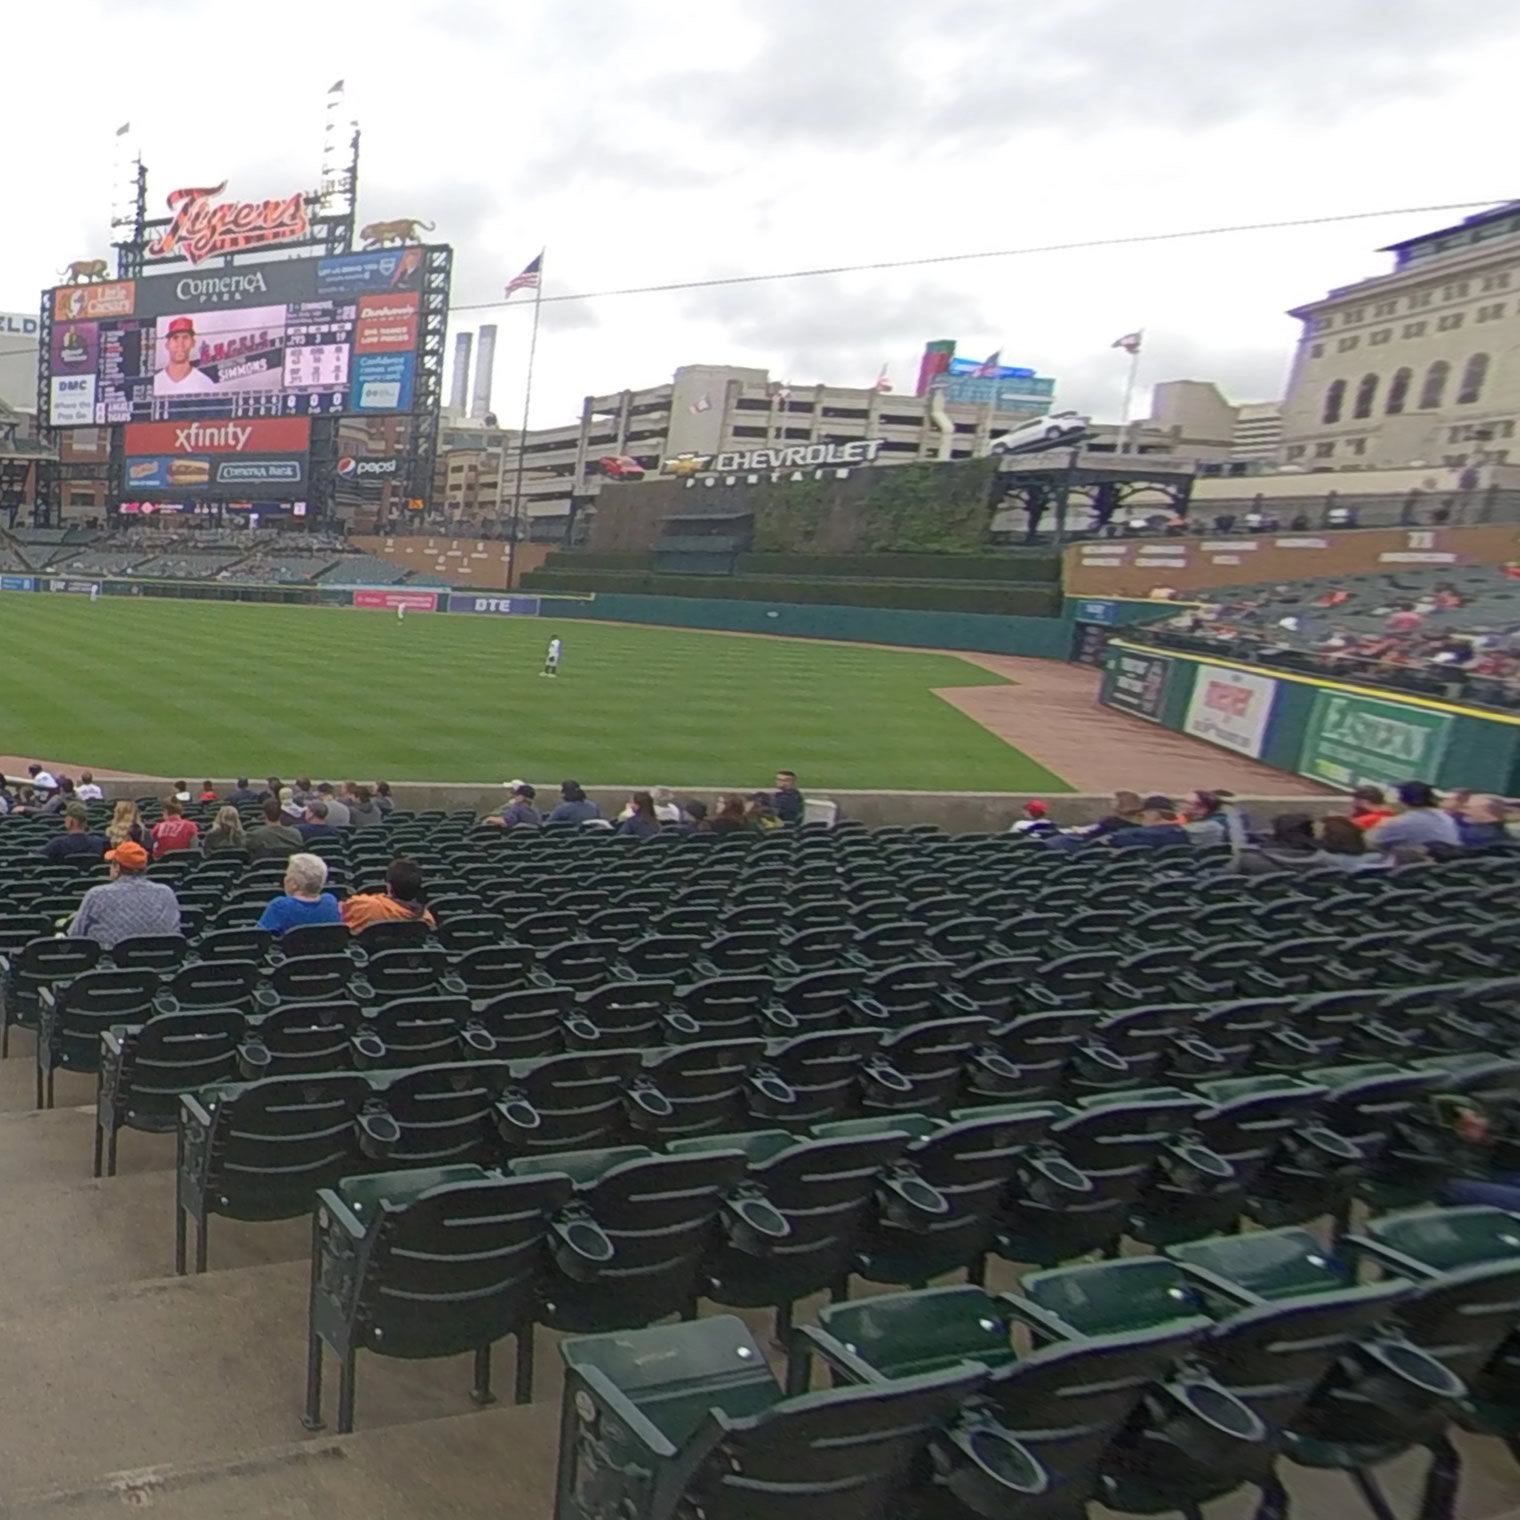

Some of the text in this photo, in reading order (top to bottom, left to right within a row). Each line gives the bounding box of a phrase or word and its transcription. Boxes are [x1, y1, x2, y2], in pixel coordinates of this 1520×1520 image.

[148, 179, 308, 266] Tigers
[96, 285, 127, 301] Little
[200, 331, 272, 364] ANGELS
[218, 358, 268, 381] SIMMONS
[58, 380, 87, 392] DMC
[174, 422, 253, 452] xfinity
[717, 439, 885, 471] CHEVROLET
[357, 460, 396, 475] pepsi
[474, 599, 511, 612] DTE
